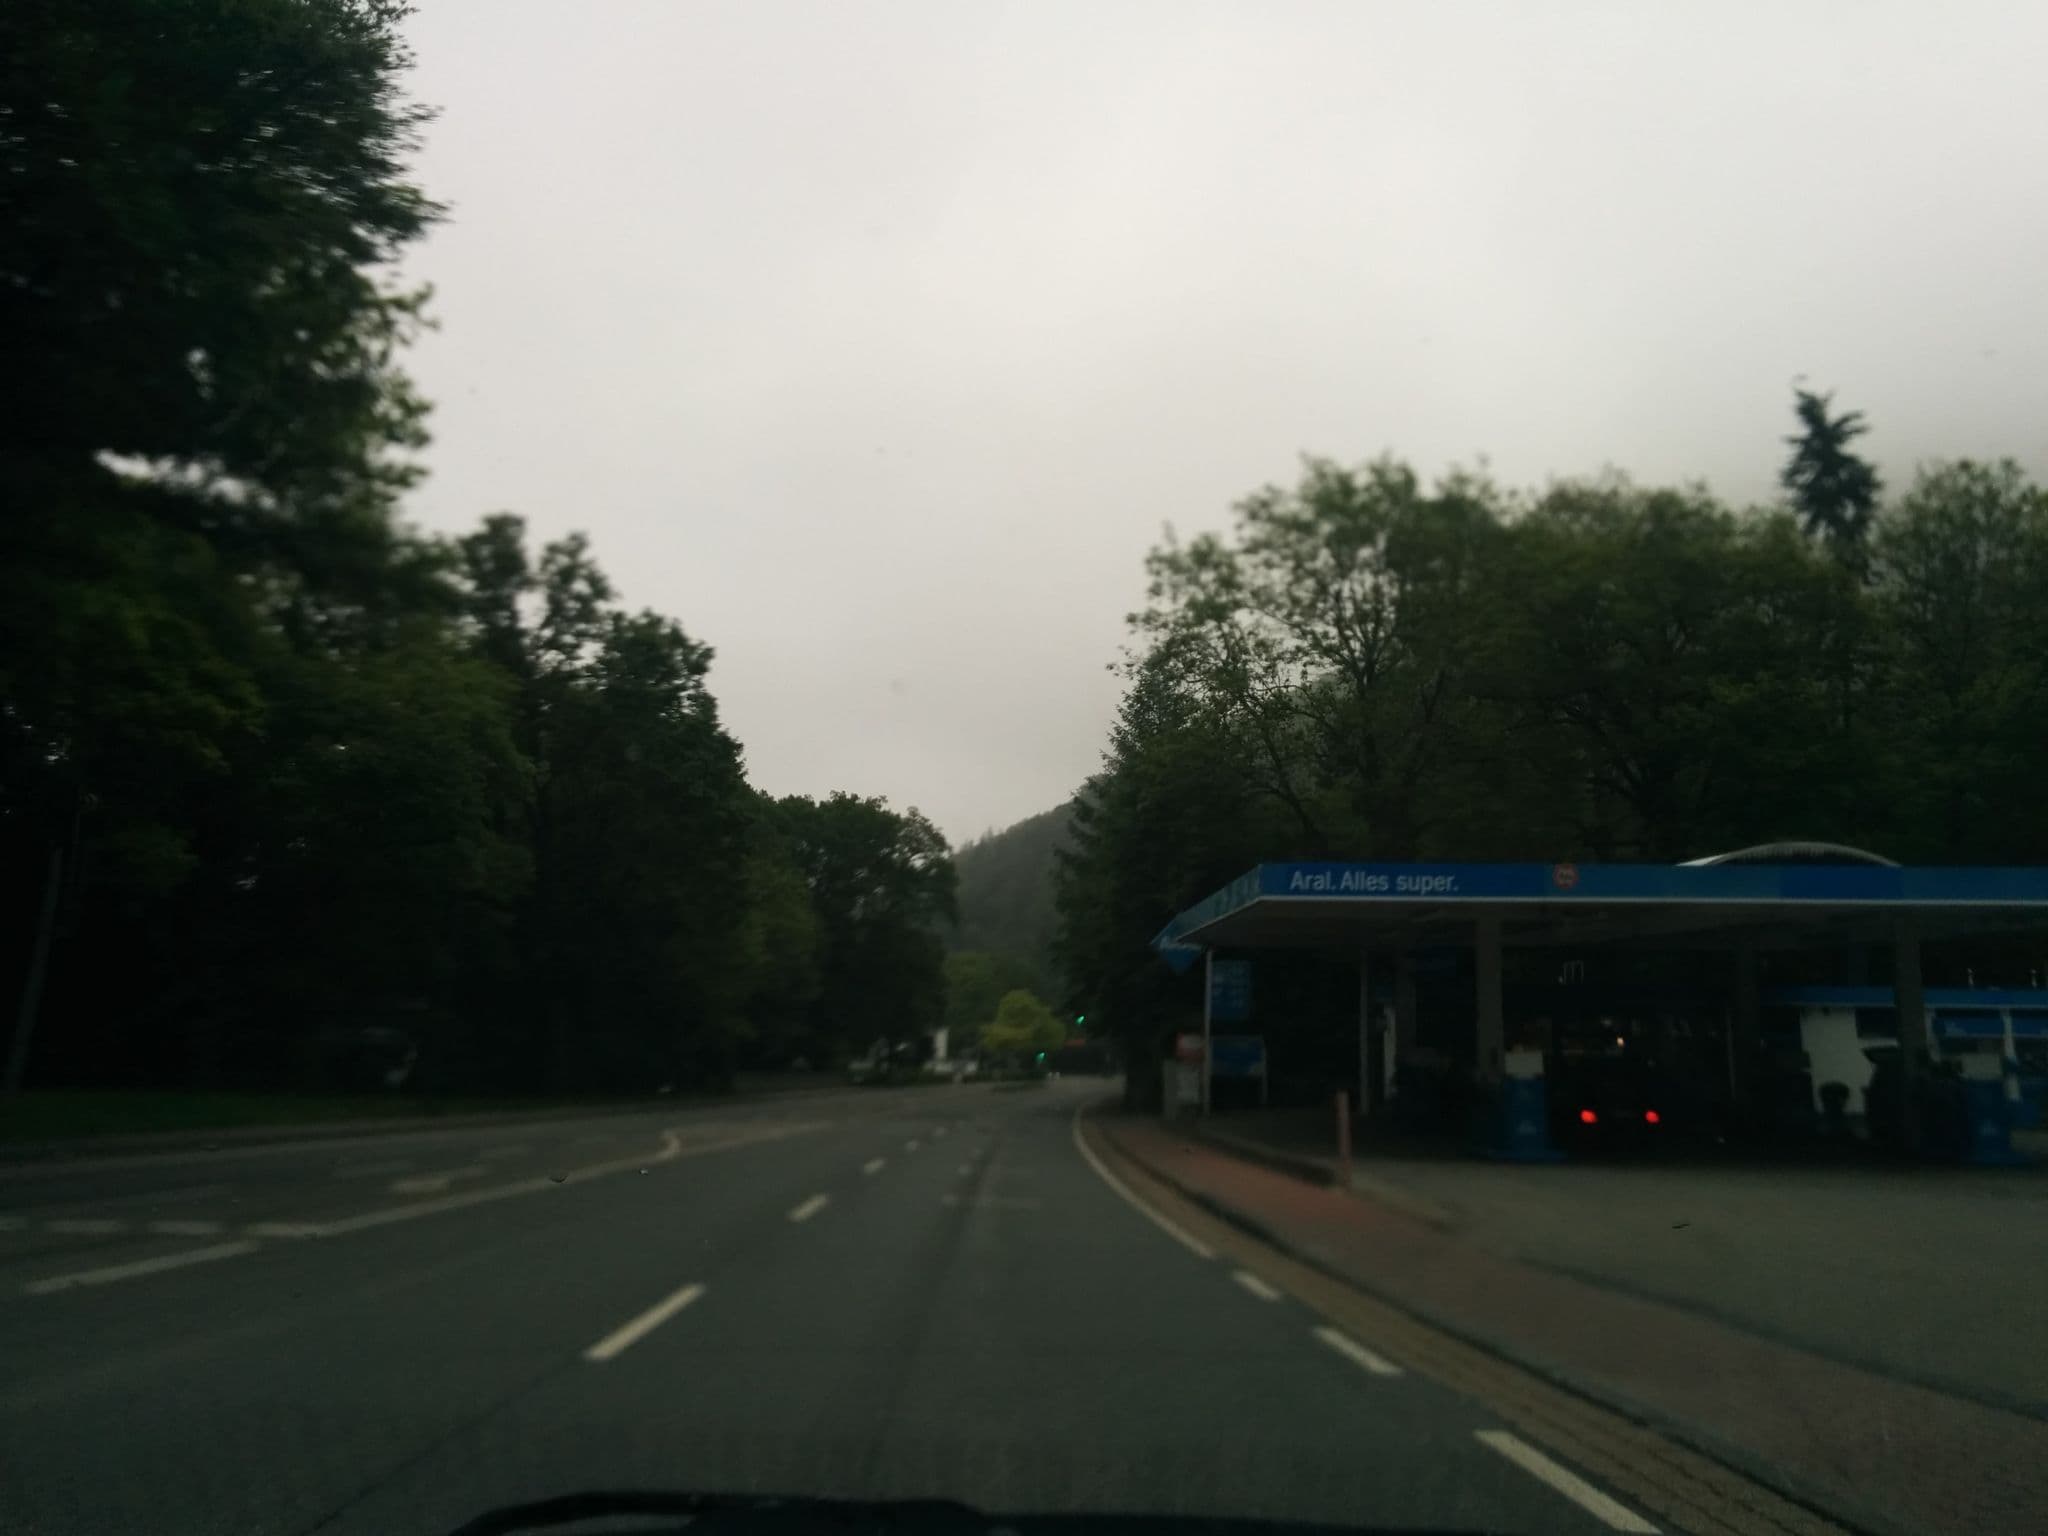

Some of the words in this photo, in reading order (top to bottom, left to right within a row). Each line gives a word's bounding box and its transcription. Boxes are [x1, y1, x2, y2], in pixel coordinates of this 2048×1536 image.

[1289, 870, 1336, 891] Aral.
[1341, 870, 1389, 892] Alles
[1396, 873, 1459, 896] super.
